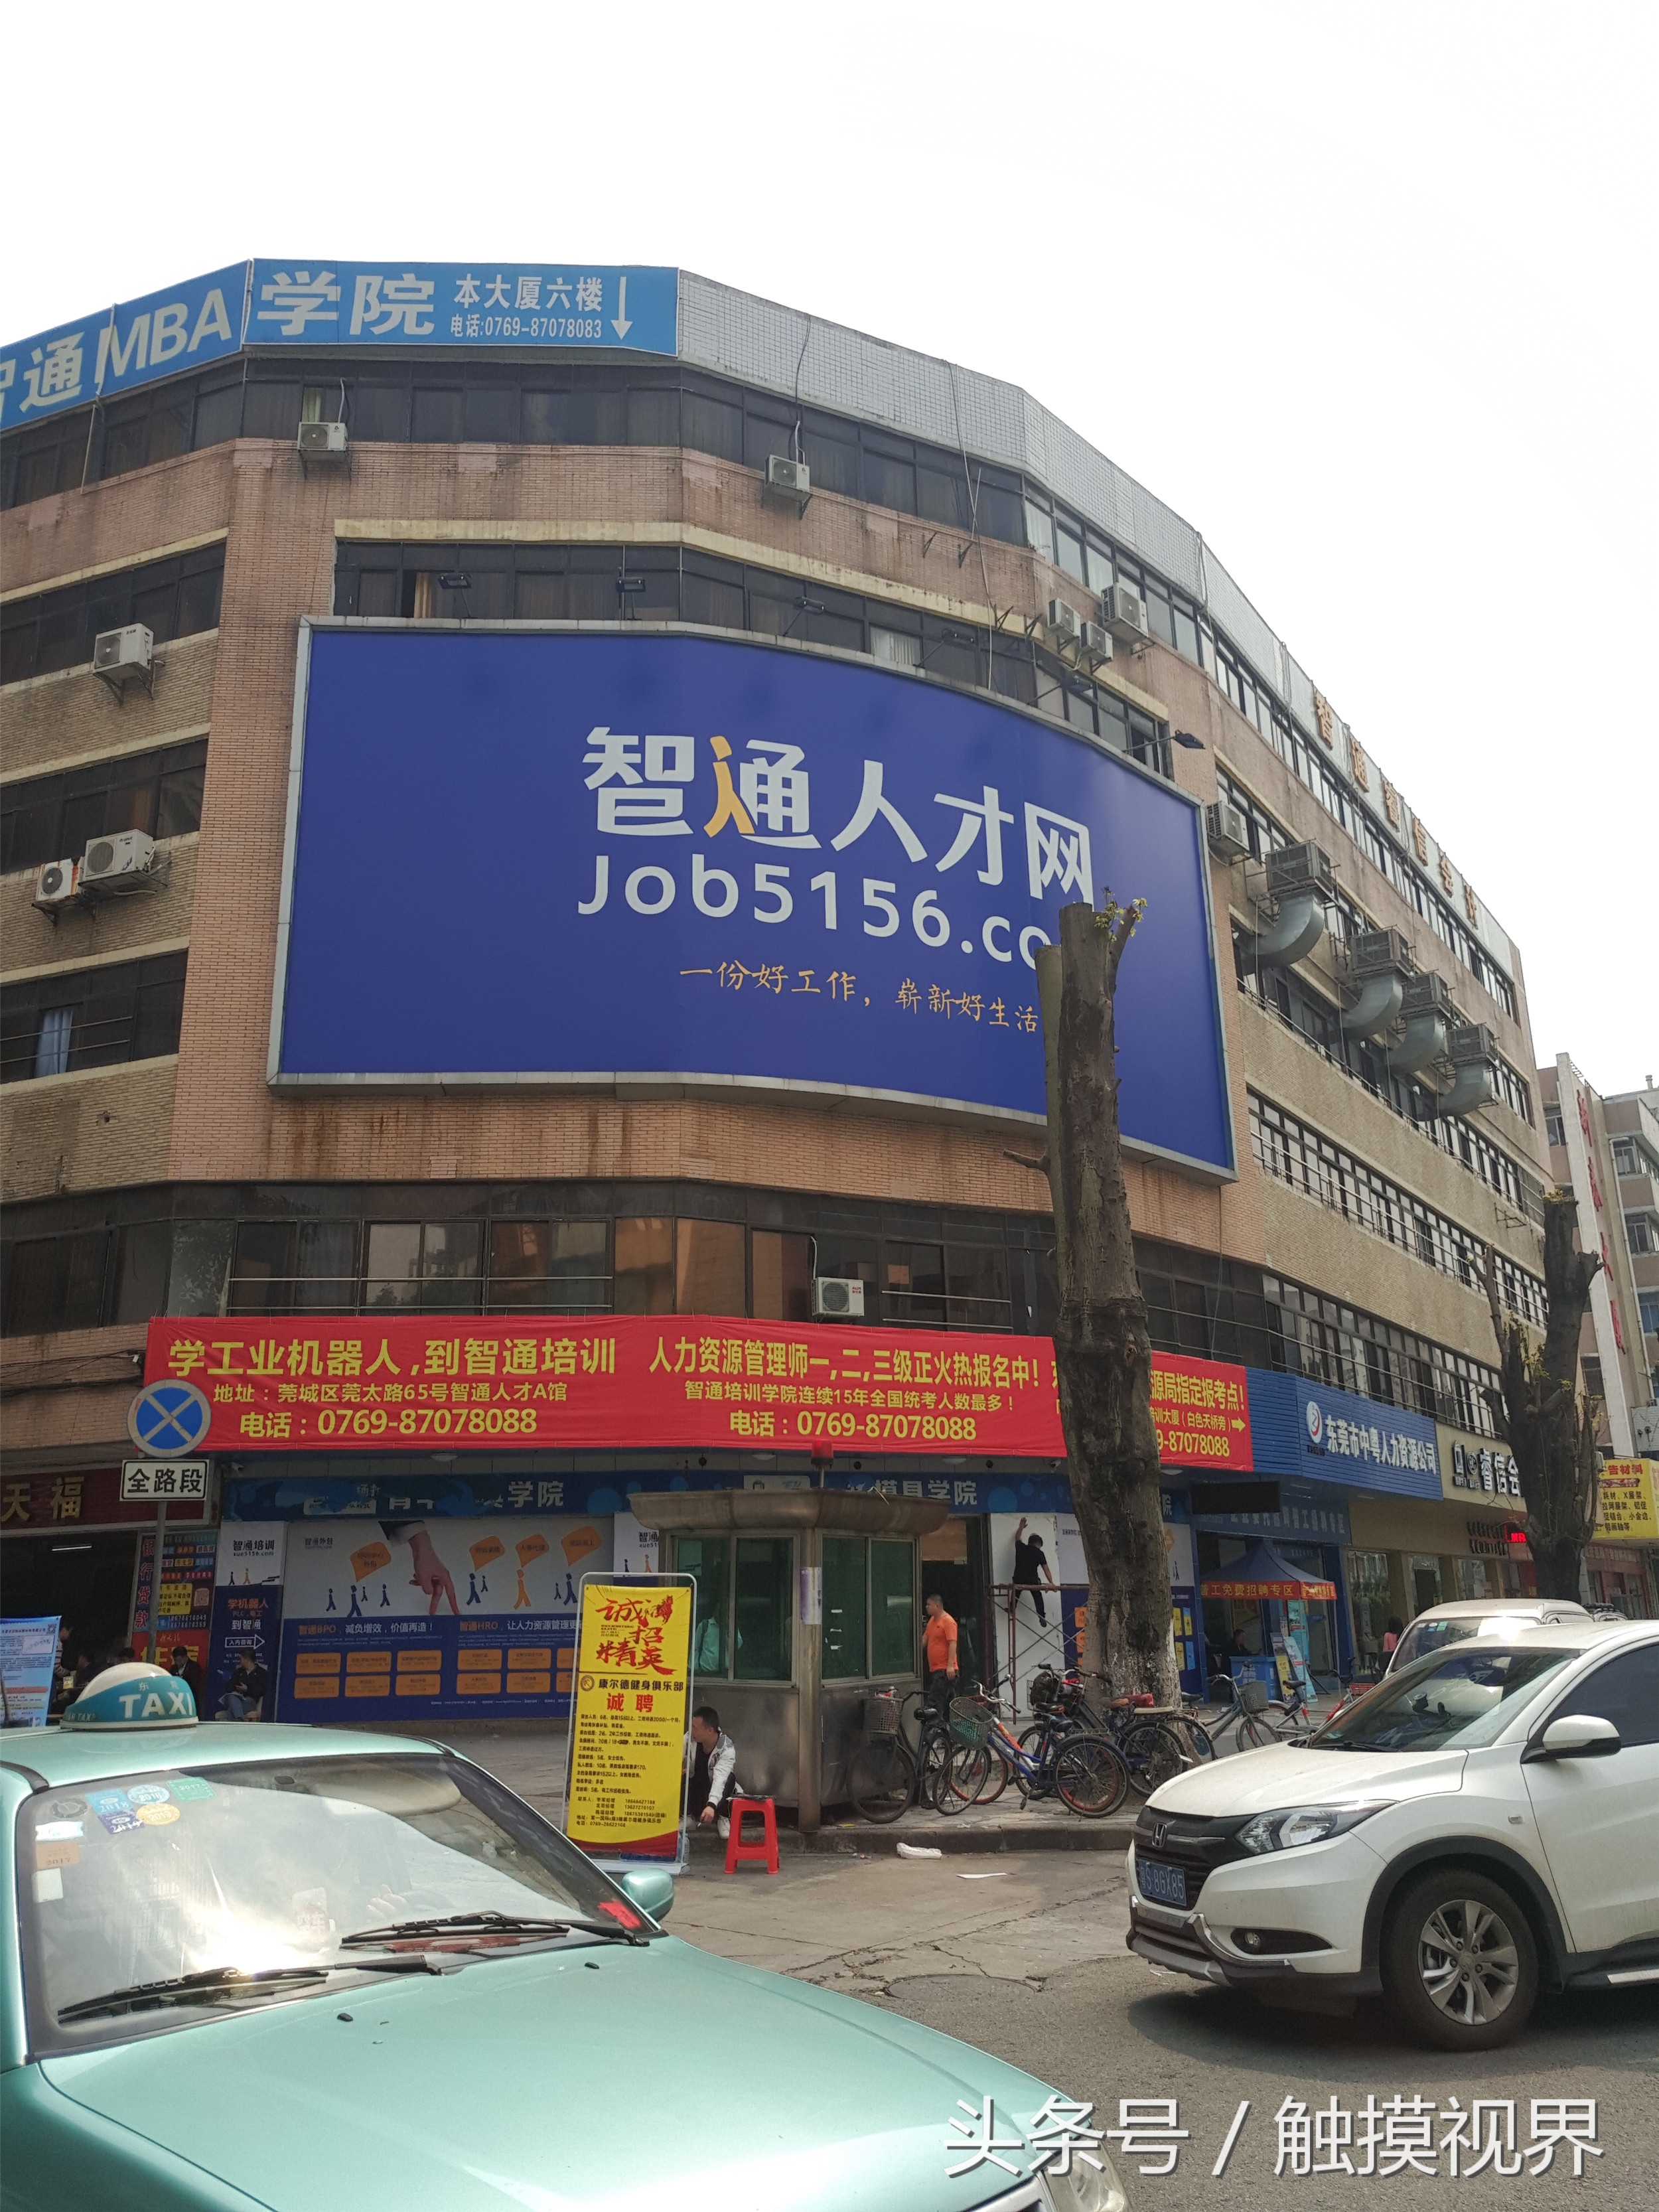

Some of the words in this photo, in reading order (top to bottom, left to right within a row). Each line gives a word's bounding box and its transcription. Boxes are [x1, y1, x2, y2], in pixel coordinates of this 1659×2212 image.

[257, 270, 435, 336] 学院
[454, 274, 603, 311] 本大厦六楼
[450, 314, 603, 340] 电话:0769-87078083
[582, 726, 1094, 912] 智通人才网
[577, 853, 1051, 972] Job5156.co
[167, 1337, 616, 1378] 学工业机器人,到智通培训
[214, 1382, 567, 1404] 地址：莞城区莞太路65号智通人才A馆
[685, 1380, 1013, 1412] 智通培训学院连续15年全国统考人数最多！
[240, 1408, 538, 1439] 电话：0769-87078088
[730, 1410, 977, 1441] 电话：0769-87078088
[1325, 1414, 1437, 1475] 东莞市中粤人力资源公司
[127, 1467, 203, 1495] 全路段
[1603, 1464, 1643, 1475] 告材料
[1, 1476, 84, 1522] 天福
[233, 1540, 275, 1552] 智通培训
[639, 1532, 659, 1542] 智通
[135, 1539, 155, 1628] 银行贷款
[1201, 1583, 1294, 1597] 普工免费招聘专区
[228, 1598, 269, 1610] 学机器人
[231, 1619, 261, 1631] 到智通
[460, 1620, 581, 1631] 智通HRO，让人力资源管理更
[228, 1639, 252, 1647] 入内咨询
[599, 1678, 684, 1692] 康尔德健身俱乐部
[119, 1692, 194, 1719] TAXI
[607, 1693, 654, 1712] 诚聘
